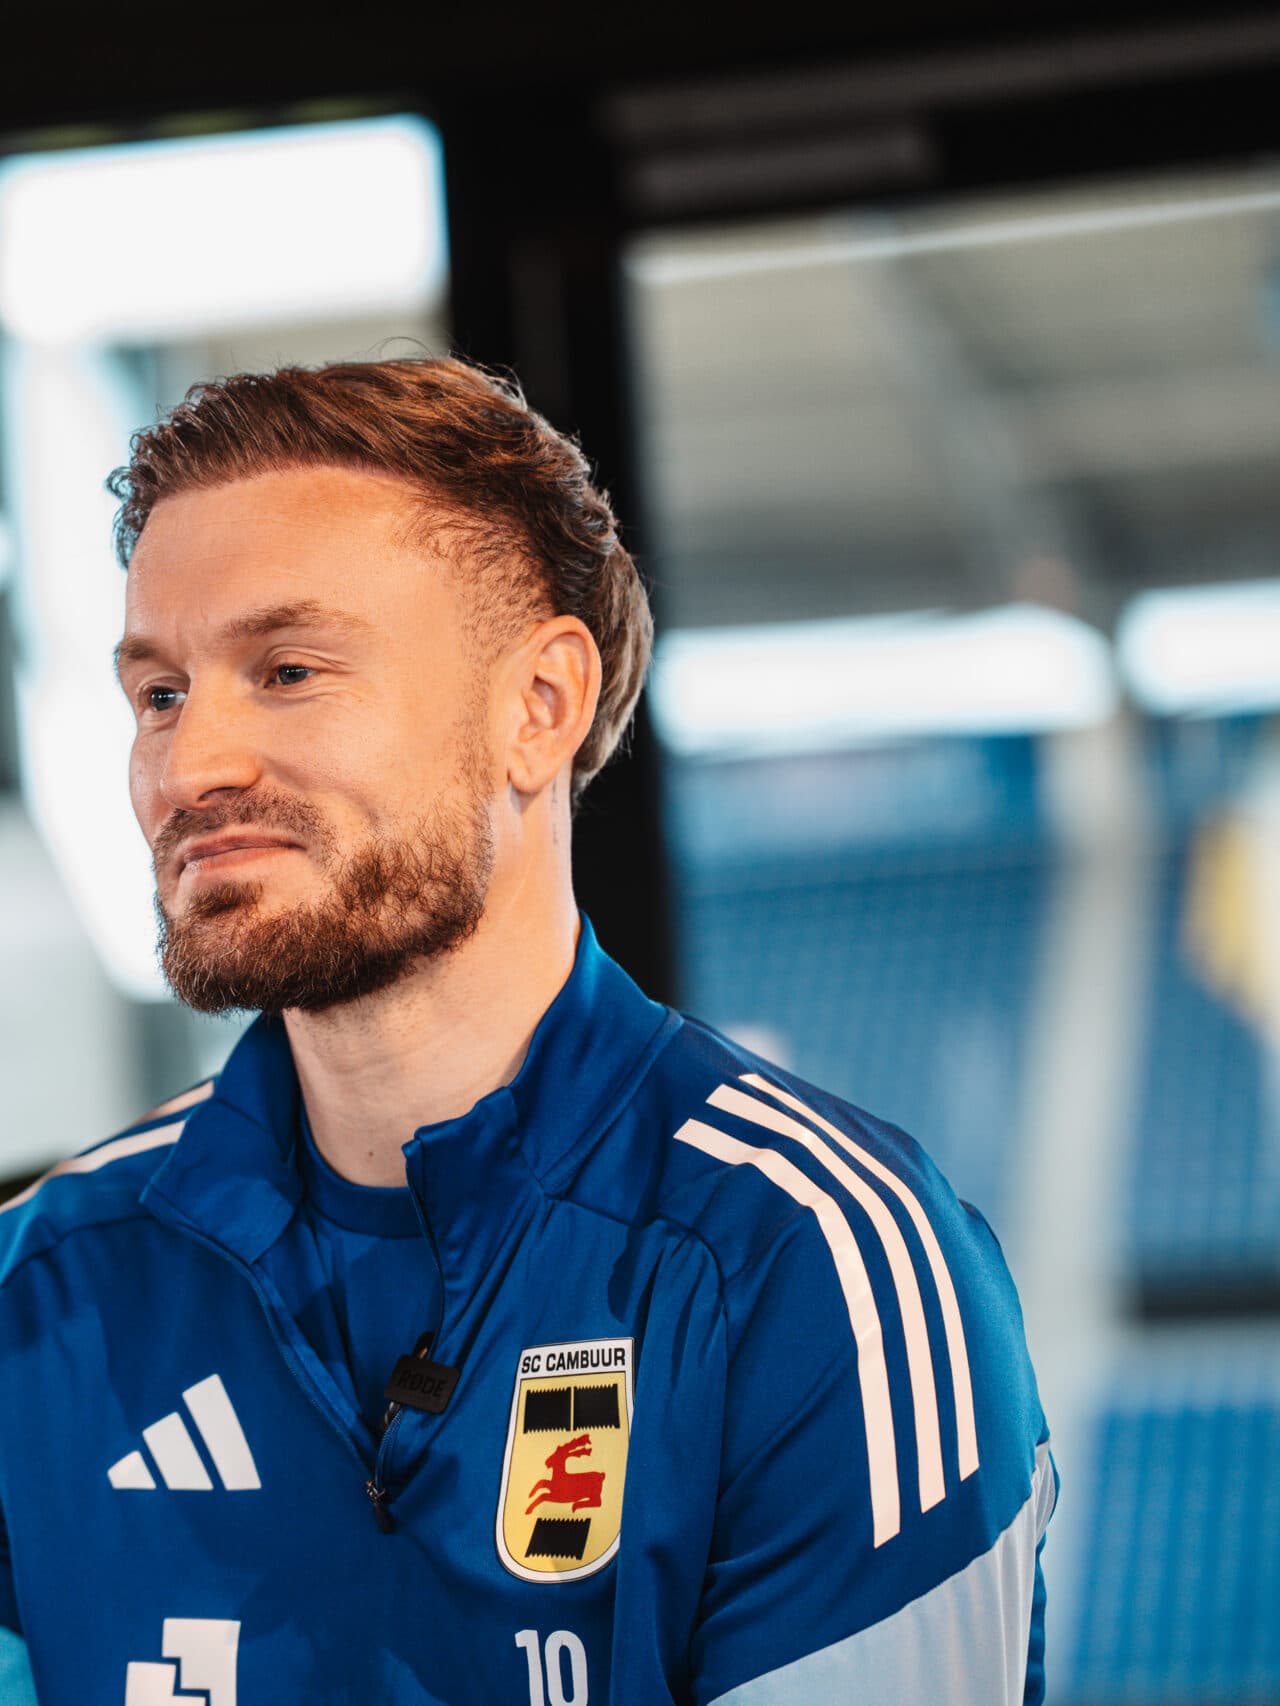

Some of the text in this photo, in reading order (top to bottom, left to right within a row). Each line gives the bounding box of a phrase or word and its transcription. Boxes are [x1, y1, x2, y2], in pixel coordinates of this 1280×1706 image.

[521, 1347, 626, 1373] SC CAMBUUR
[515, 1629, 588, 1706] 10
